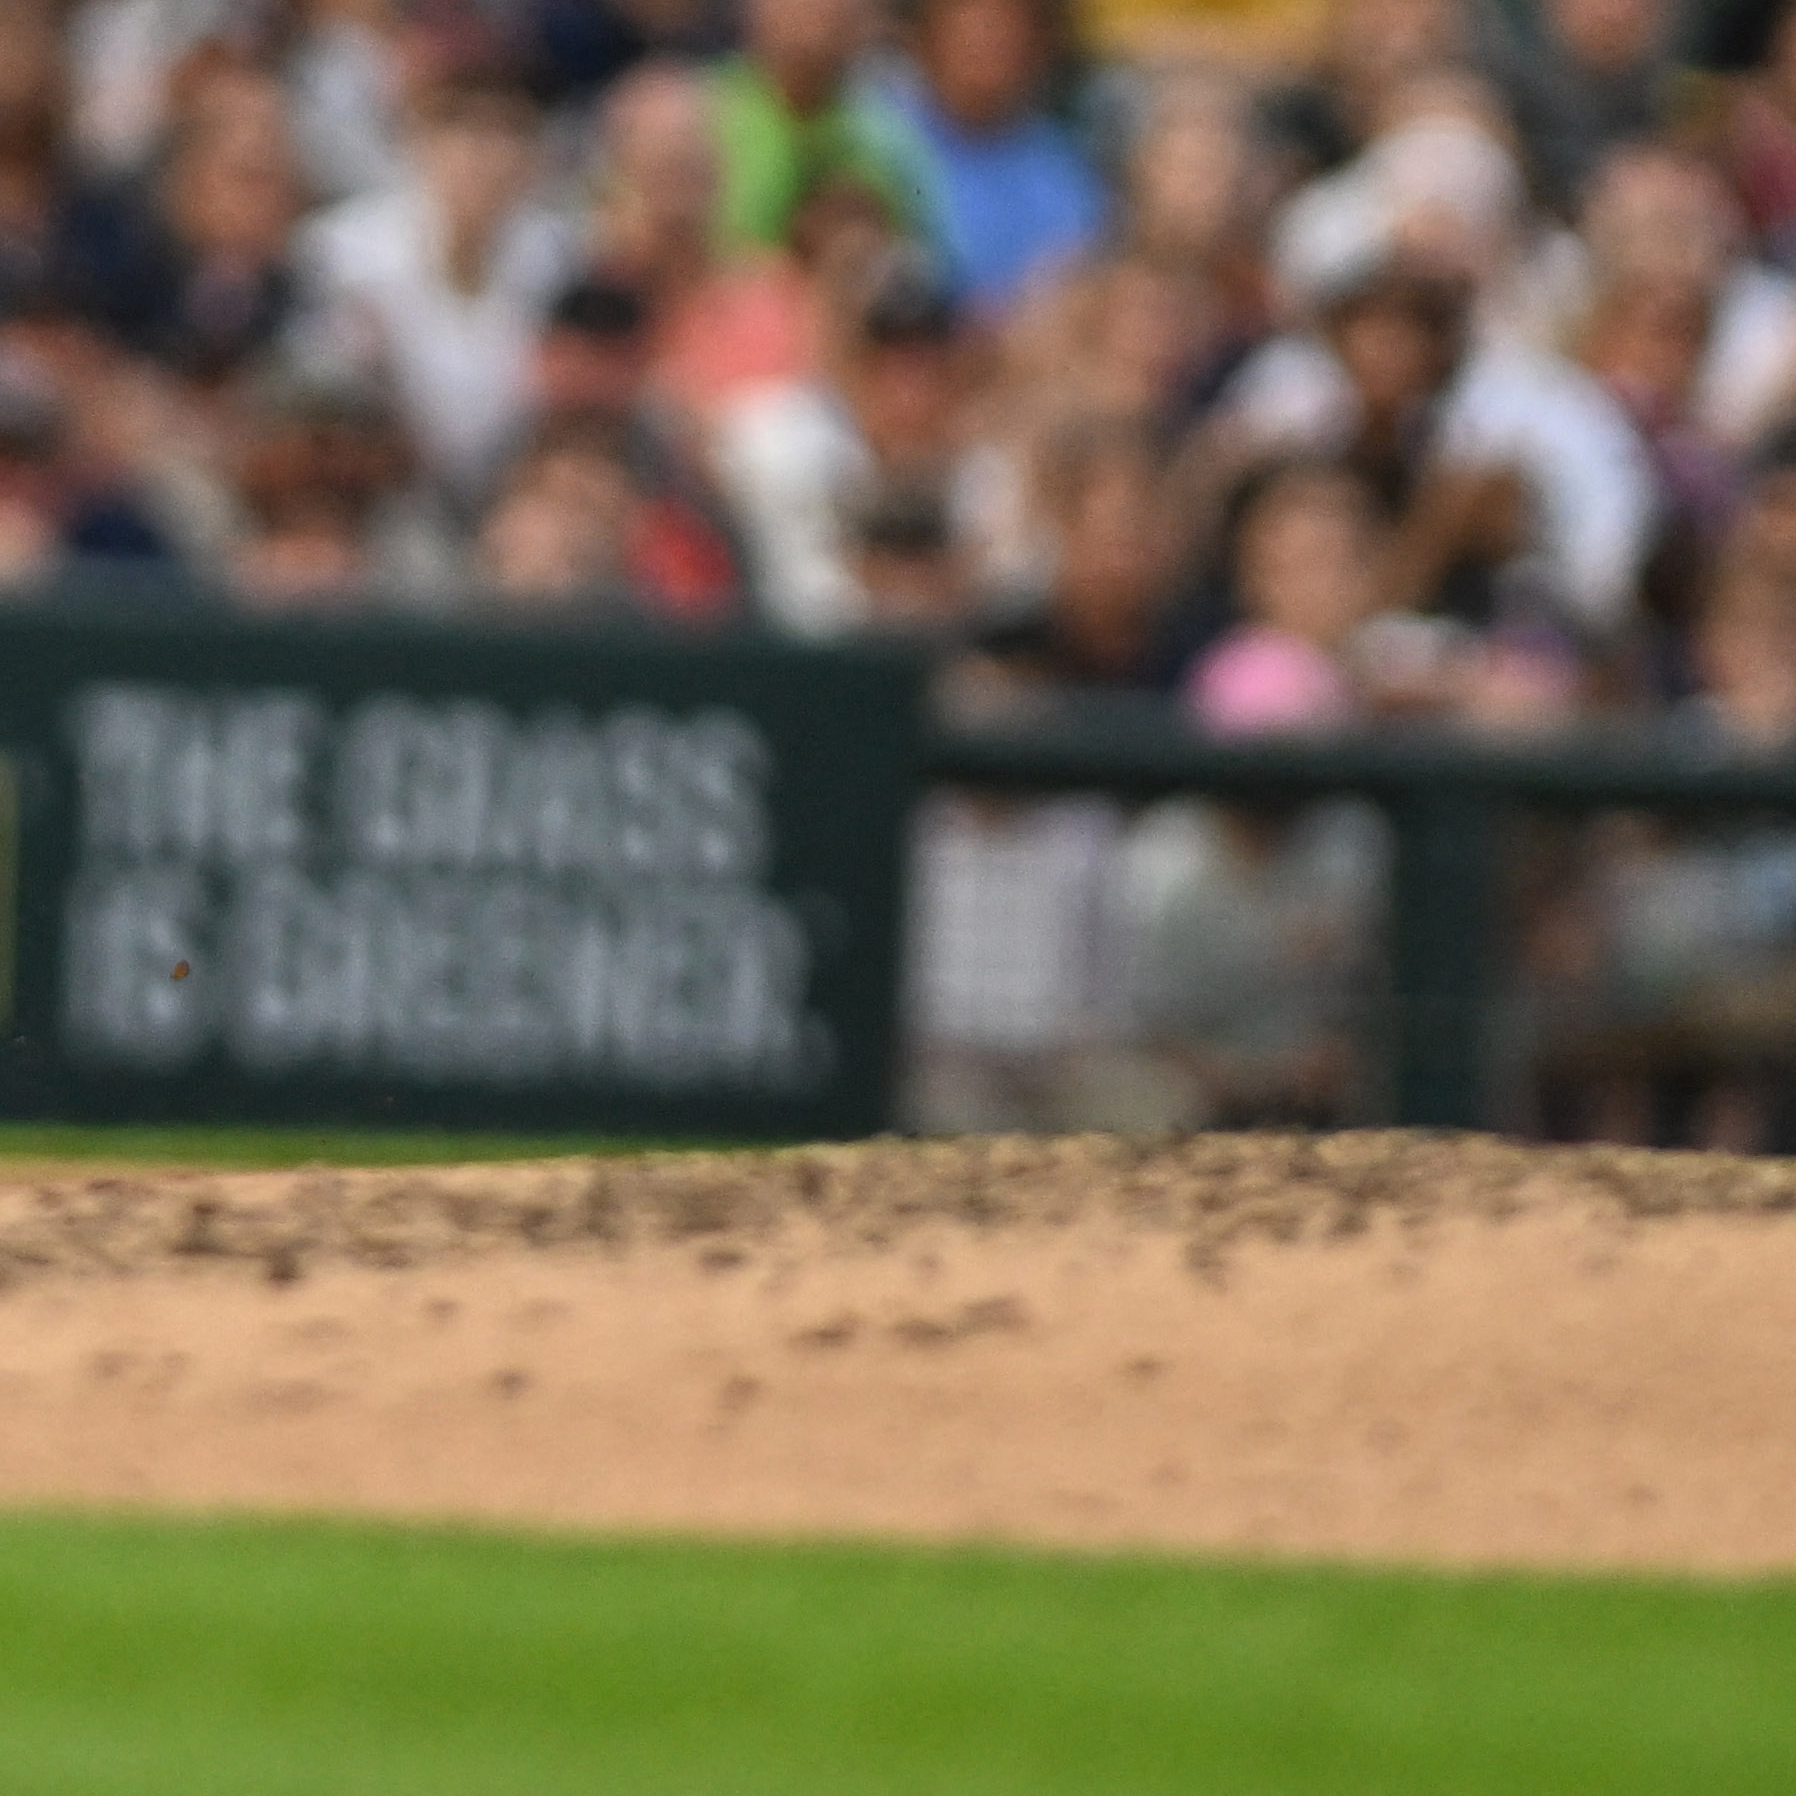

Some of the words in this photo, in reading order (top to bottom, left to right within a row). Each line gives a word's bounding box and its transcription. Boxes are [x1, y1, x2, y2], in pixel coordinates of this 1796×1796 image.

[78, 686, 310, 856] THE
[336, 696, 778, 872] GRASS
[68, 884, 208, 1052] IS
